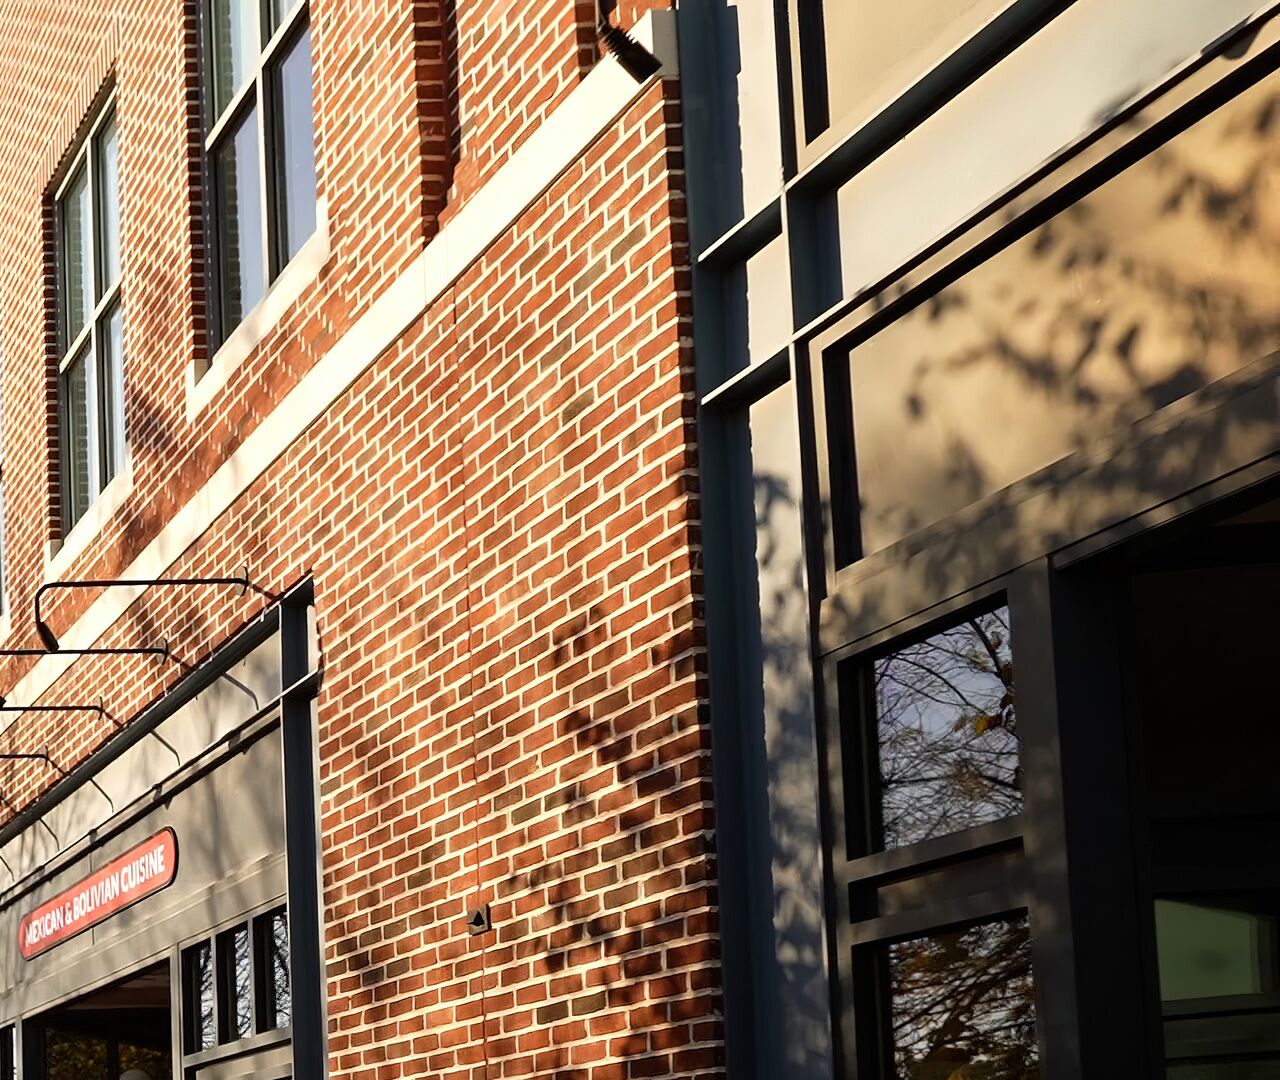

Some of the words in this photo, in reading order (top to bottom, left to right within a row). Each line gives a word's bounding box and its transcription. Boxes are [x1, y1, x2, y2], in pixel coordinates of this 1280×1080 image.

[25, 905, 64, 947] MEXICAN
[64, 902, 73, 926] &
[72, 871, 120, 921] BOLIVIAN
[120, 844, 166, 893] CUISINE
